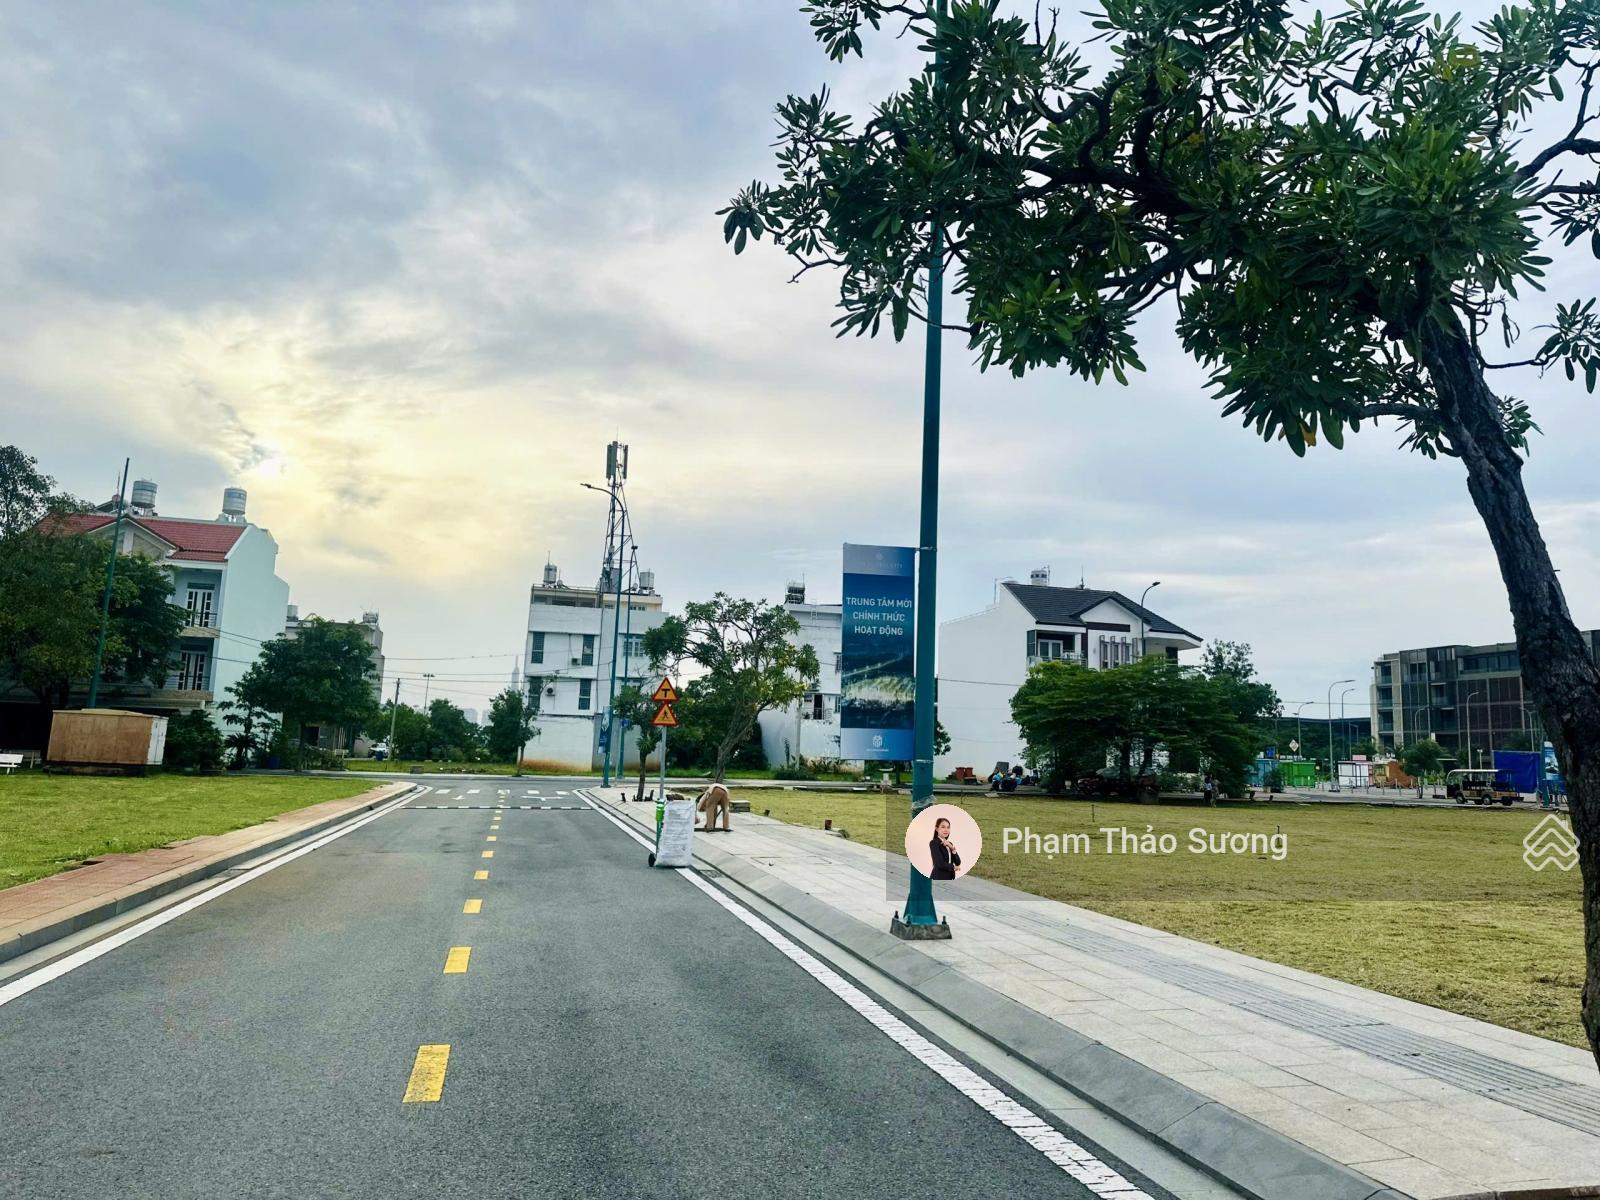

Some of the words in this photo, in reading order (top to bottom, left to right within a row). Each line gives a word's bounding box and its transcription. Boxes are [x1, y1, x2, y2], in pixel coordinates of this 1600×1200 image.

[846, 597, 875, 606] TRUNG
[877, 596, 894, 607] TÂM
[896, 597, 912, 608] MỚI
[853, 610, 880, 620] CHÍNH
[881, 611, 905, 621] THỨC
[854, 625, 877, 636] HOẠT
[879, 624, 903, 637] ĐỘNG
